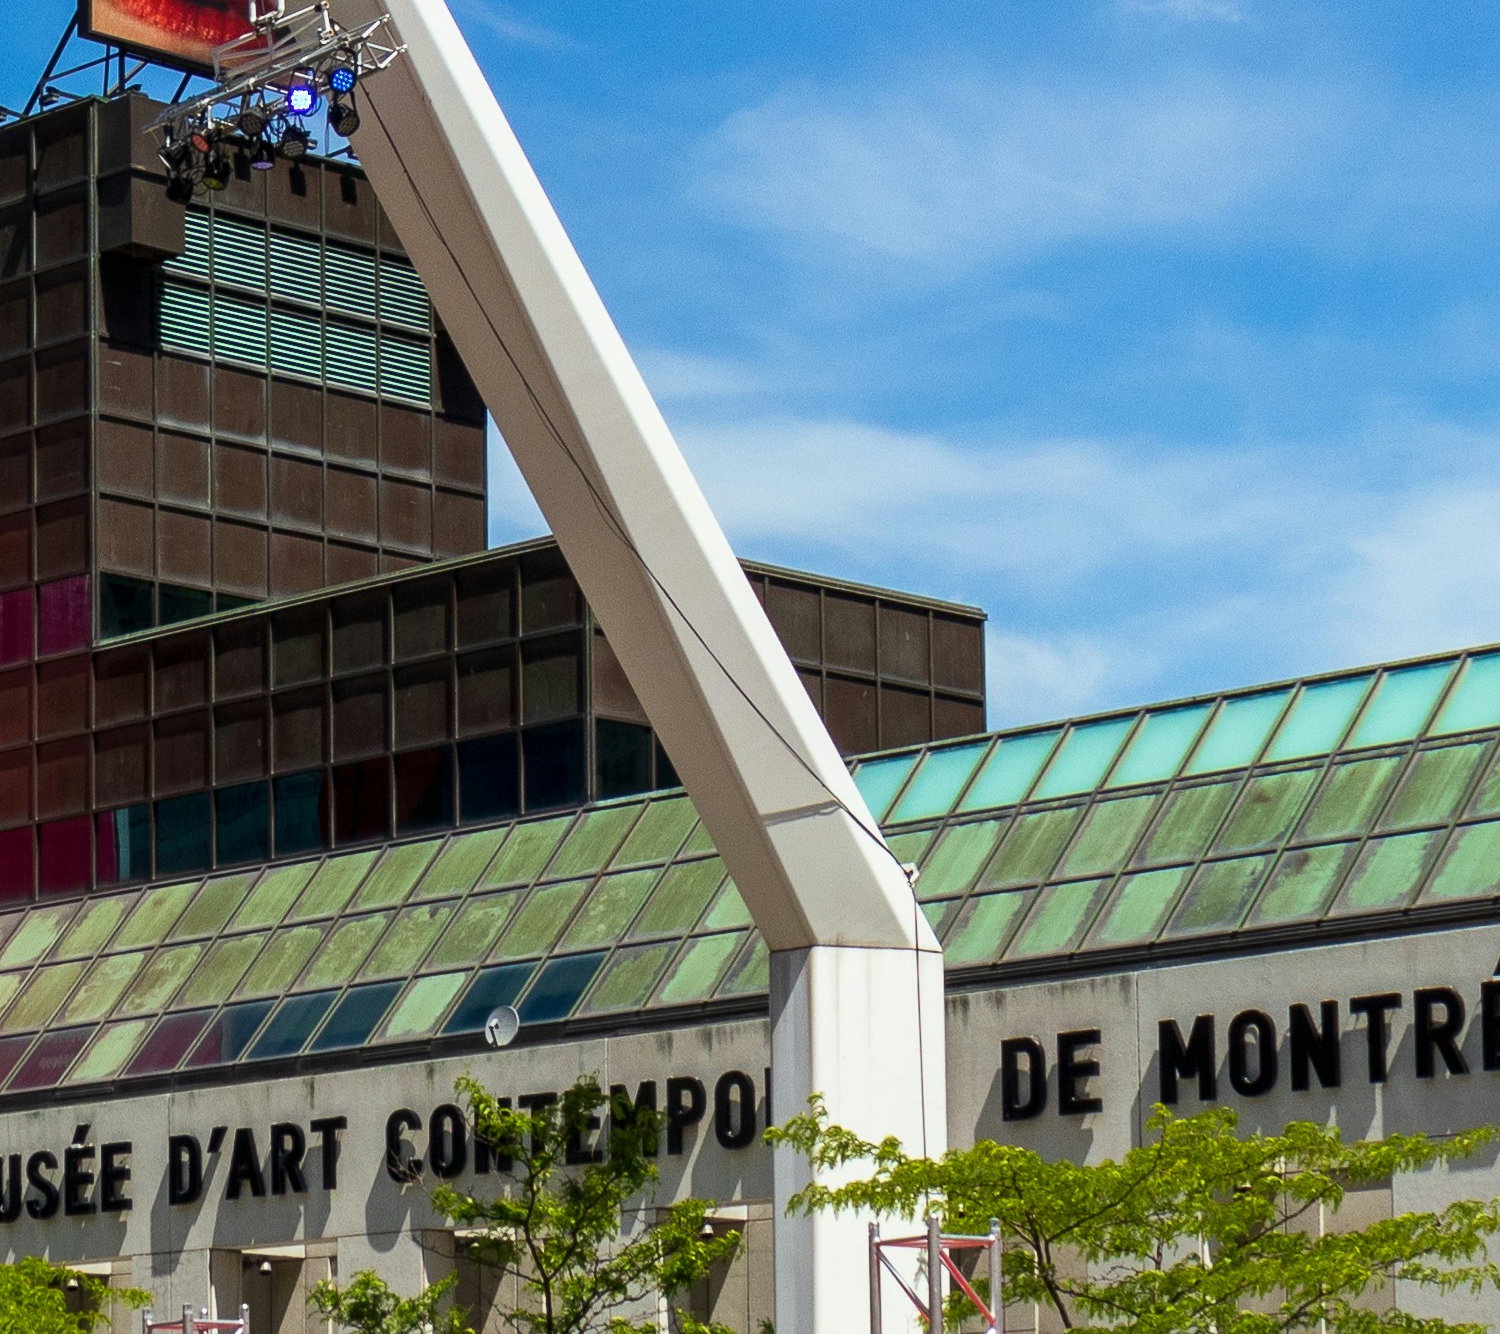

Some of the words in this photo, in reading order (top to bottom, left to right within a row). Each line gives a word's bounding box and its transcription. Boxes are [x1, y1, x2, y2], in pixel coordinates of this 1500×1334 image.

[168, 1115, 348, 1207] D'ART
[385, 1067, 772, 1184] CONTEMPO
[1001, 1028, 1103, 1122] DE
